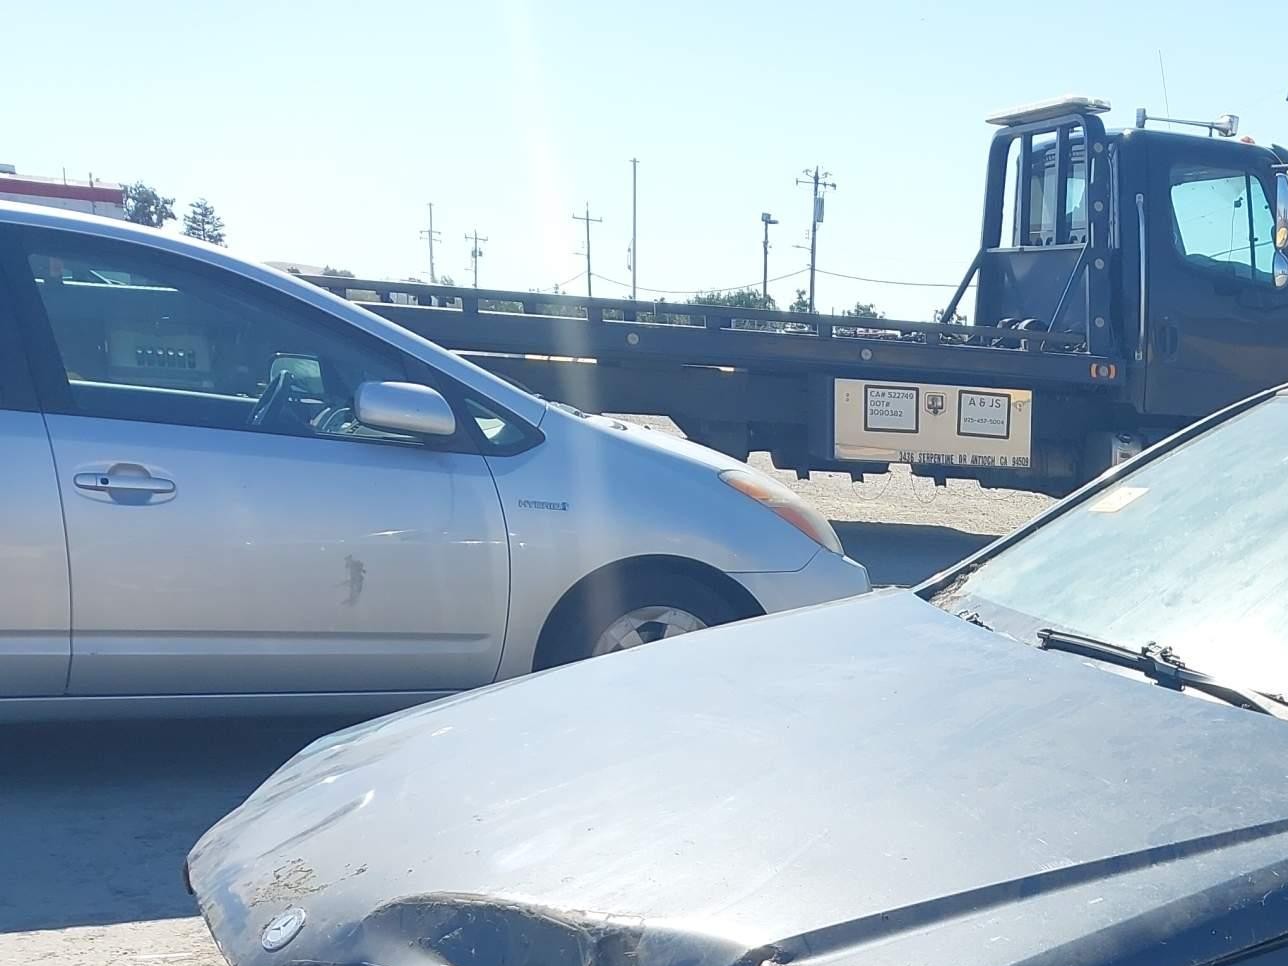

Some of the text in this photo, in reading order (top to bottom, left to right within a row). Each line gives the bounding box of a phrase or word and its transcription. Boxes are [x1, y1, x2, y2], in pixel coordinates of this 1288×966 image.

[968, 397, 1001, 409] A & JS
[918, 452, 954, 465] SERPENTINE
[958, 454, 968, 465] DR
[970, 455, 996, 466] ANTIOCH
[999, 456, 1008, 466] CA
[1011, 456, 1029, 467] 94509
